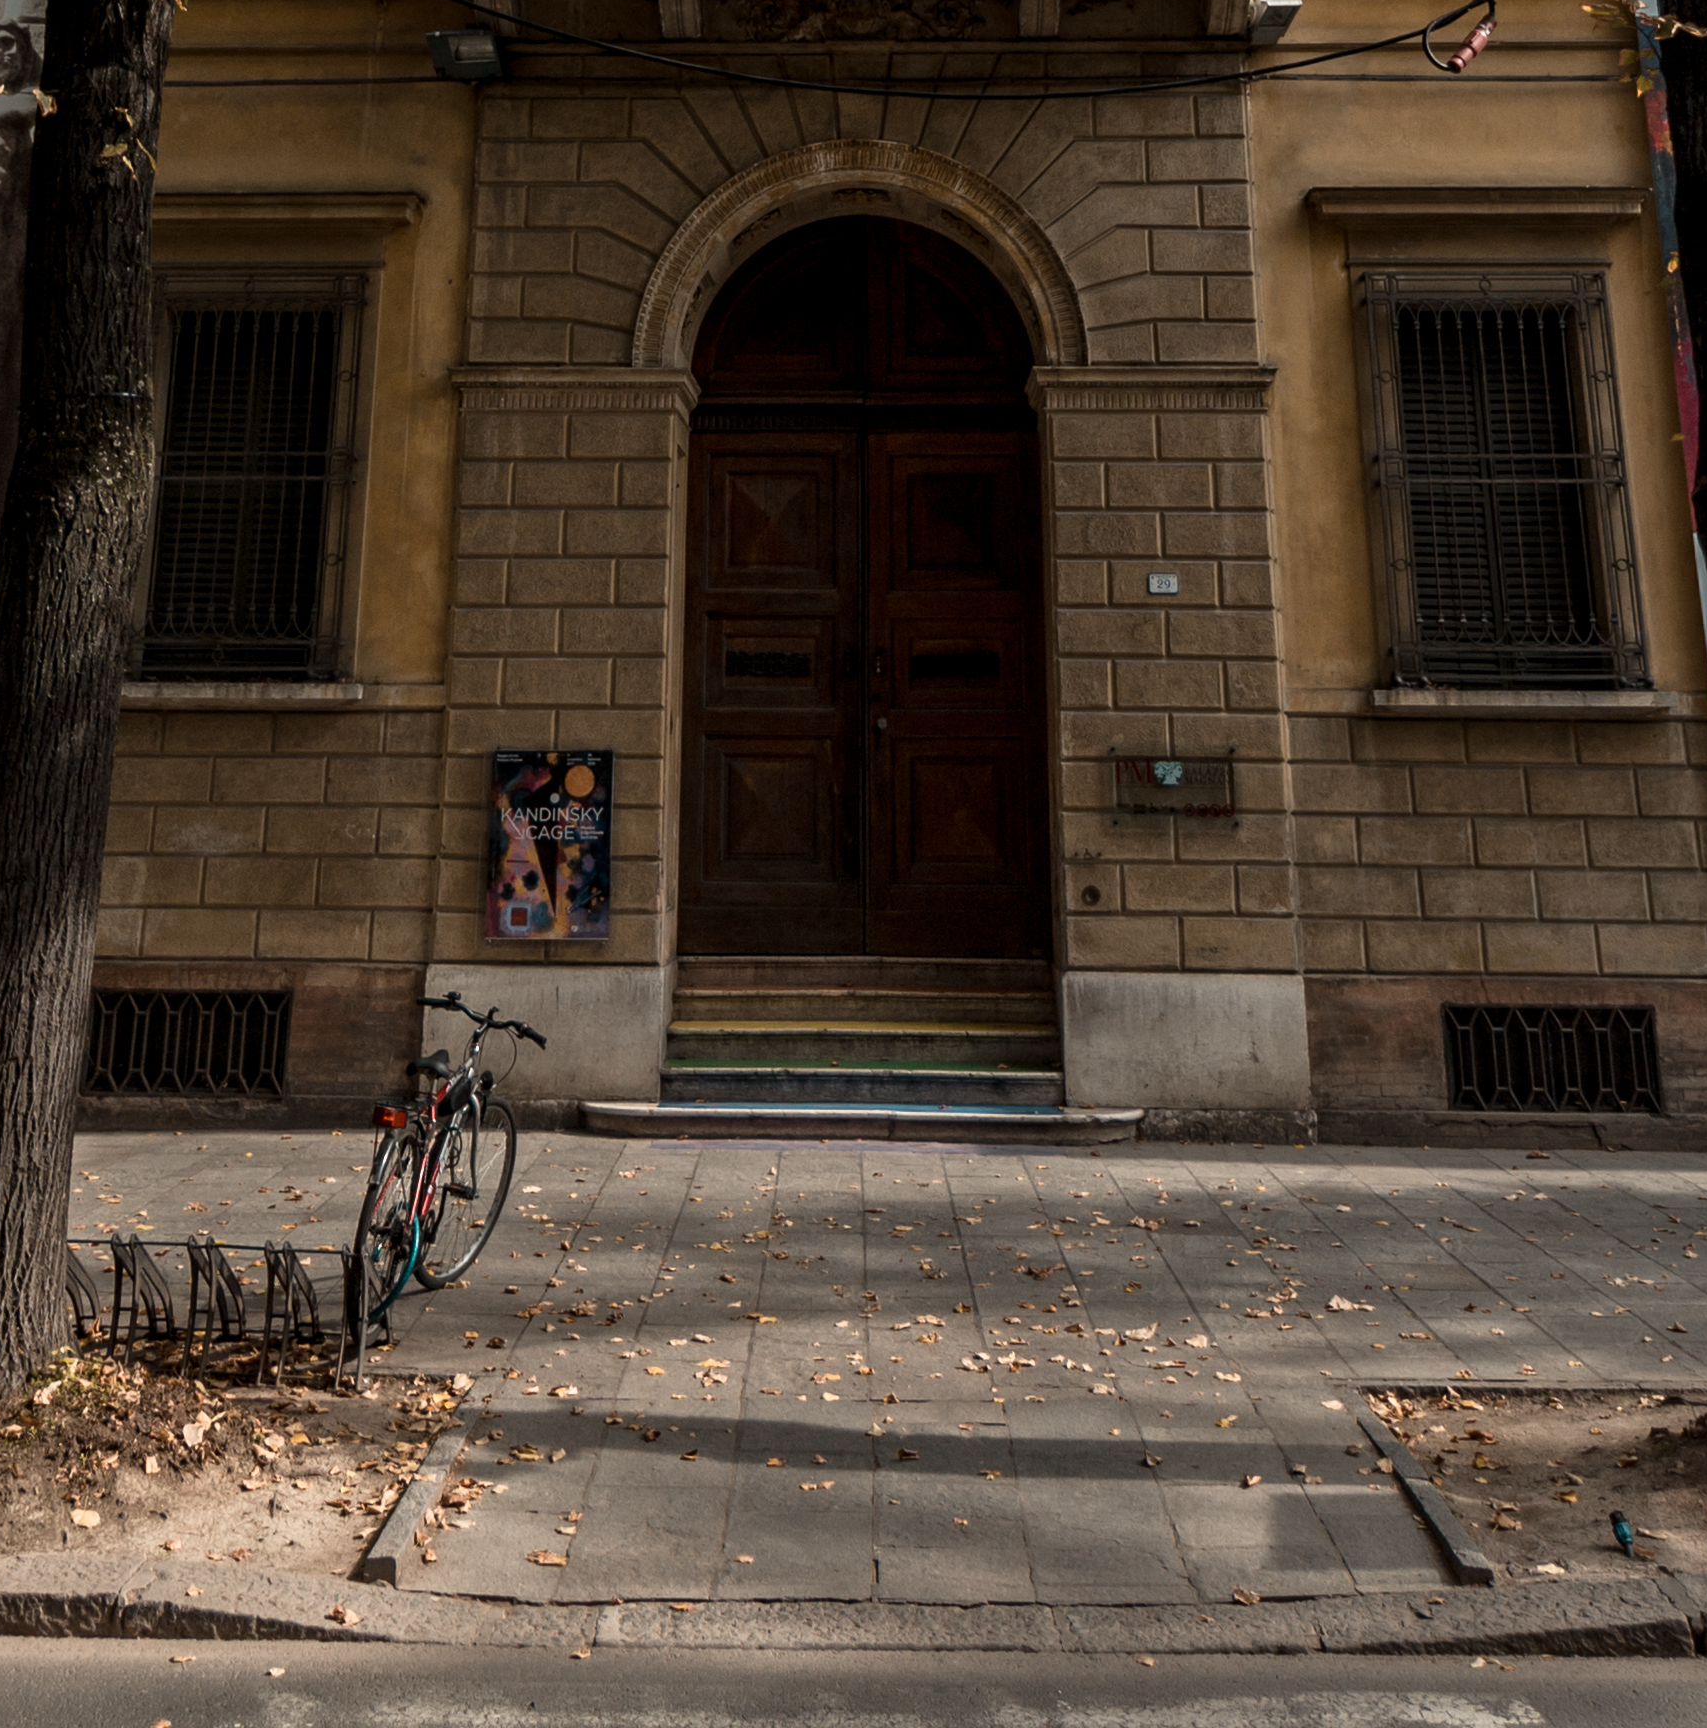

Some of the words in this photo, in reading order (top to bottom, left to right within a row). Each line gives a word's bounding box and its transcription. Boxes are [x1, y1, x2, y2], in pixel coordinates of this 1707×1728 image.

[1156, 578, 1171, 589] 29
[500, 806, 604, 822] KANDINSKY
[525, 824, 575, 840] CAGE
